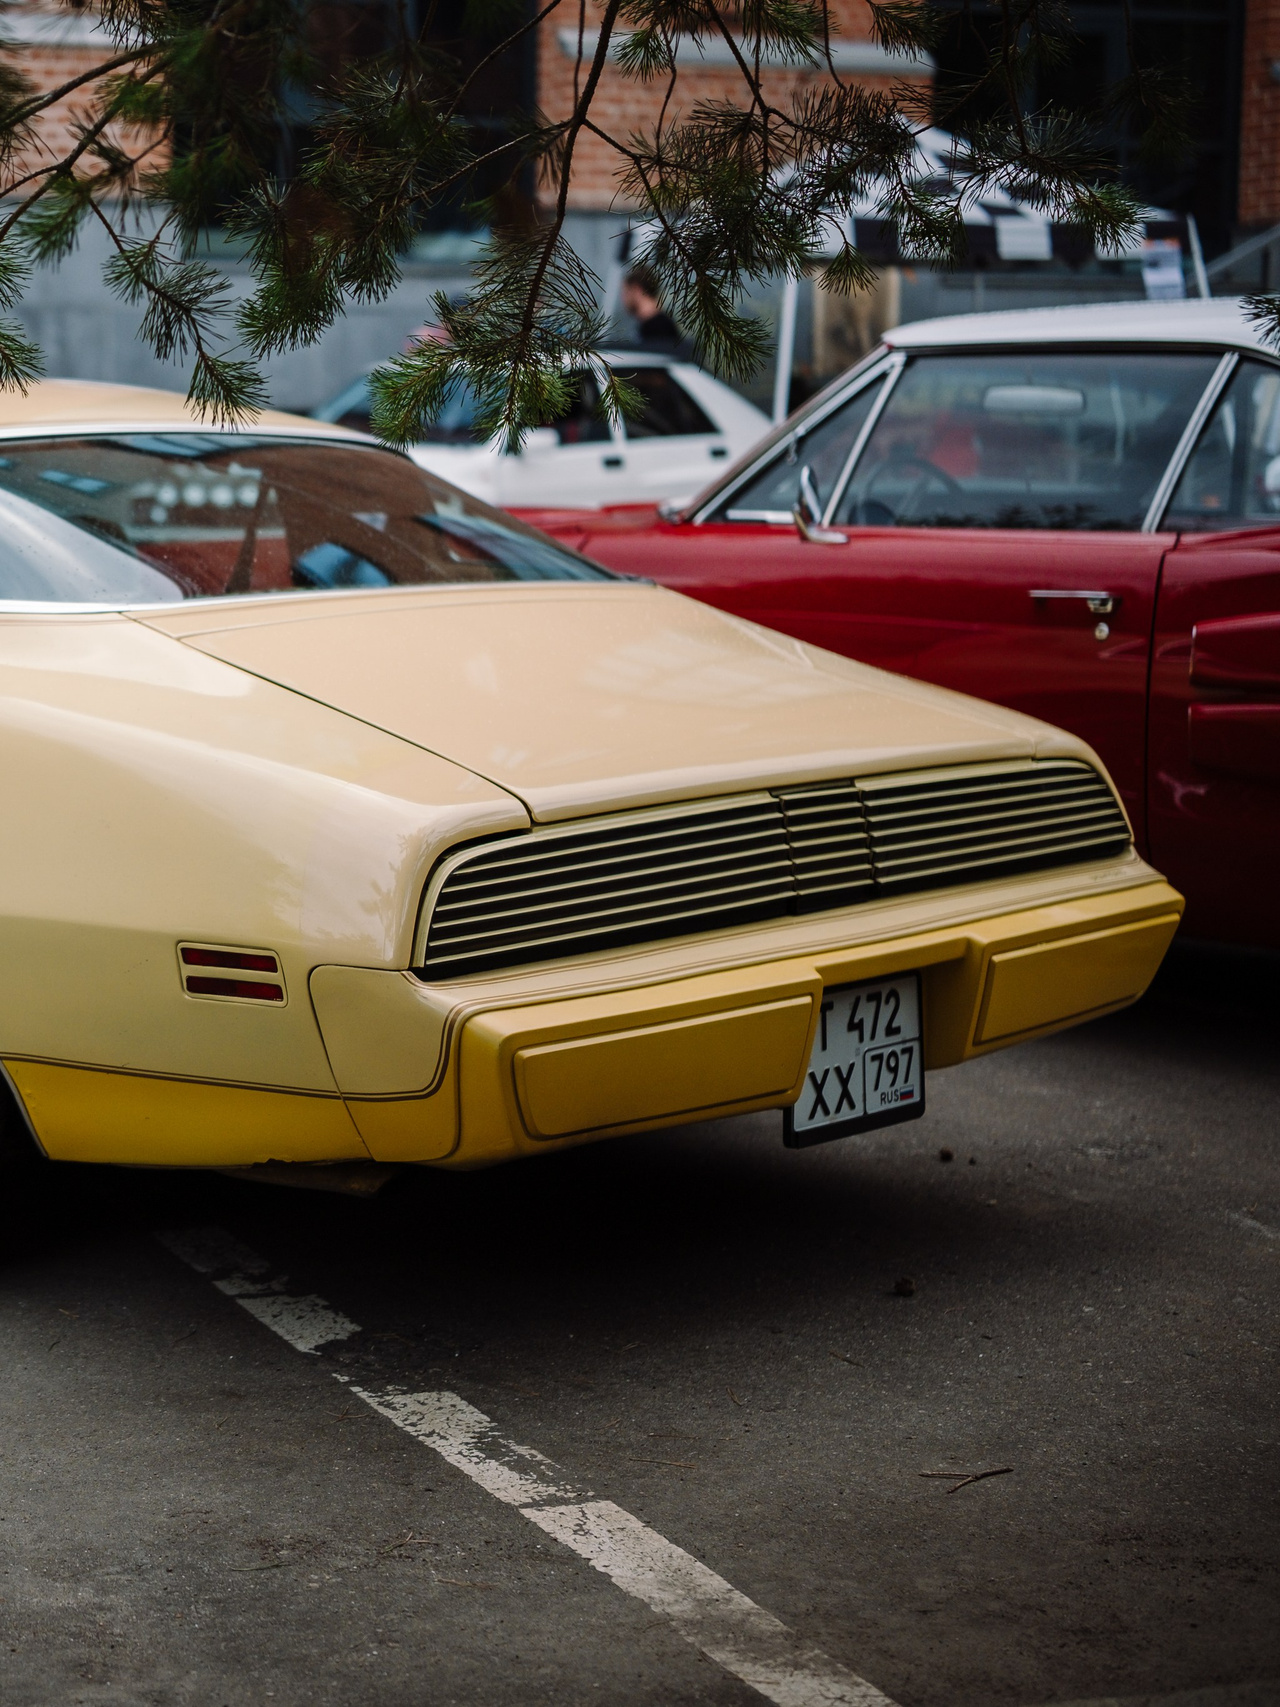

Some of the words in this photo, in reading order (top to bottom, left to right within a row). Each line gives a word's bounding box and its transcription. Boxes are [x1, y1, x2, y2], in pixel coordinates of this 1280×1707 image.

[847, 987, 902, 1044] 472
[808, 1060, 856, 1121] XX
[870, 1046, 914, 1092] 797
[880, 1090, 900, 1106] RUS
